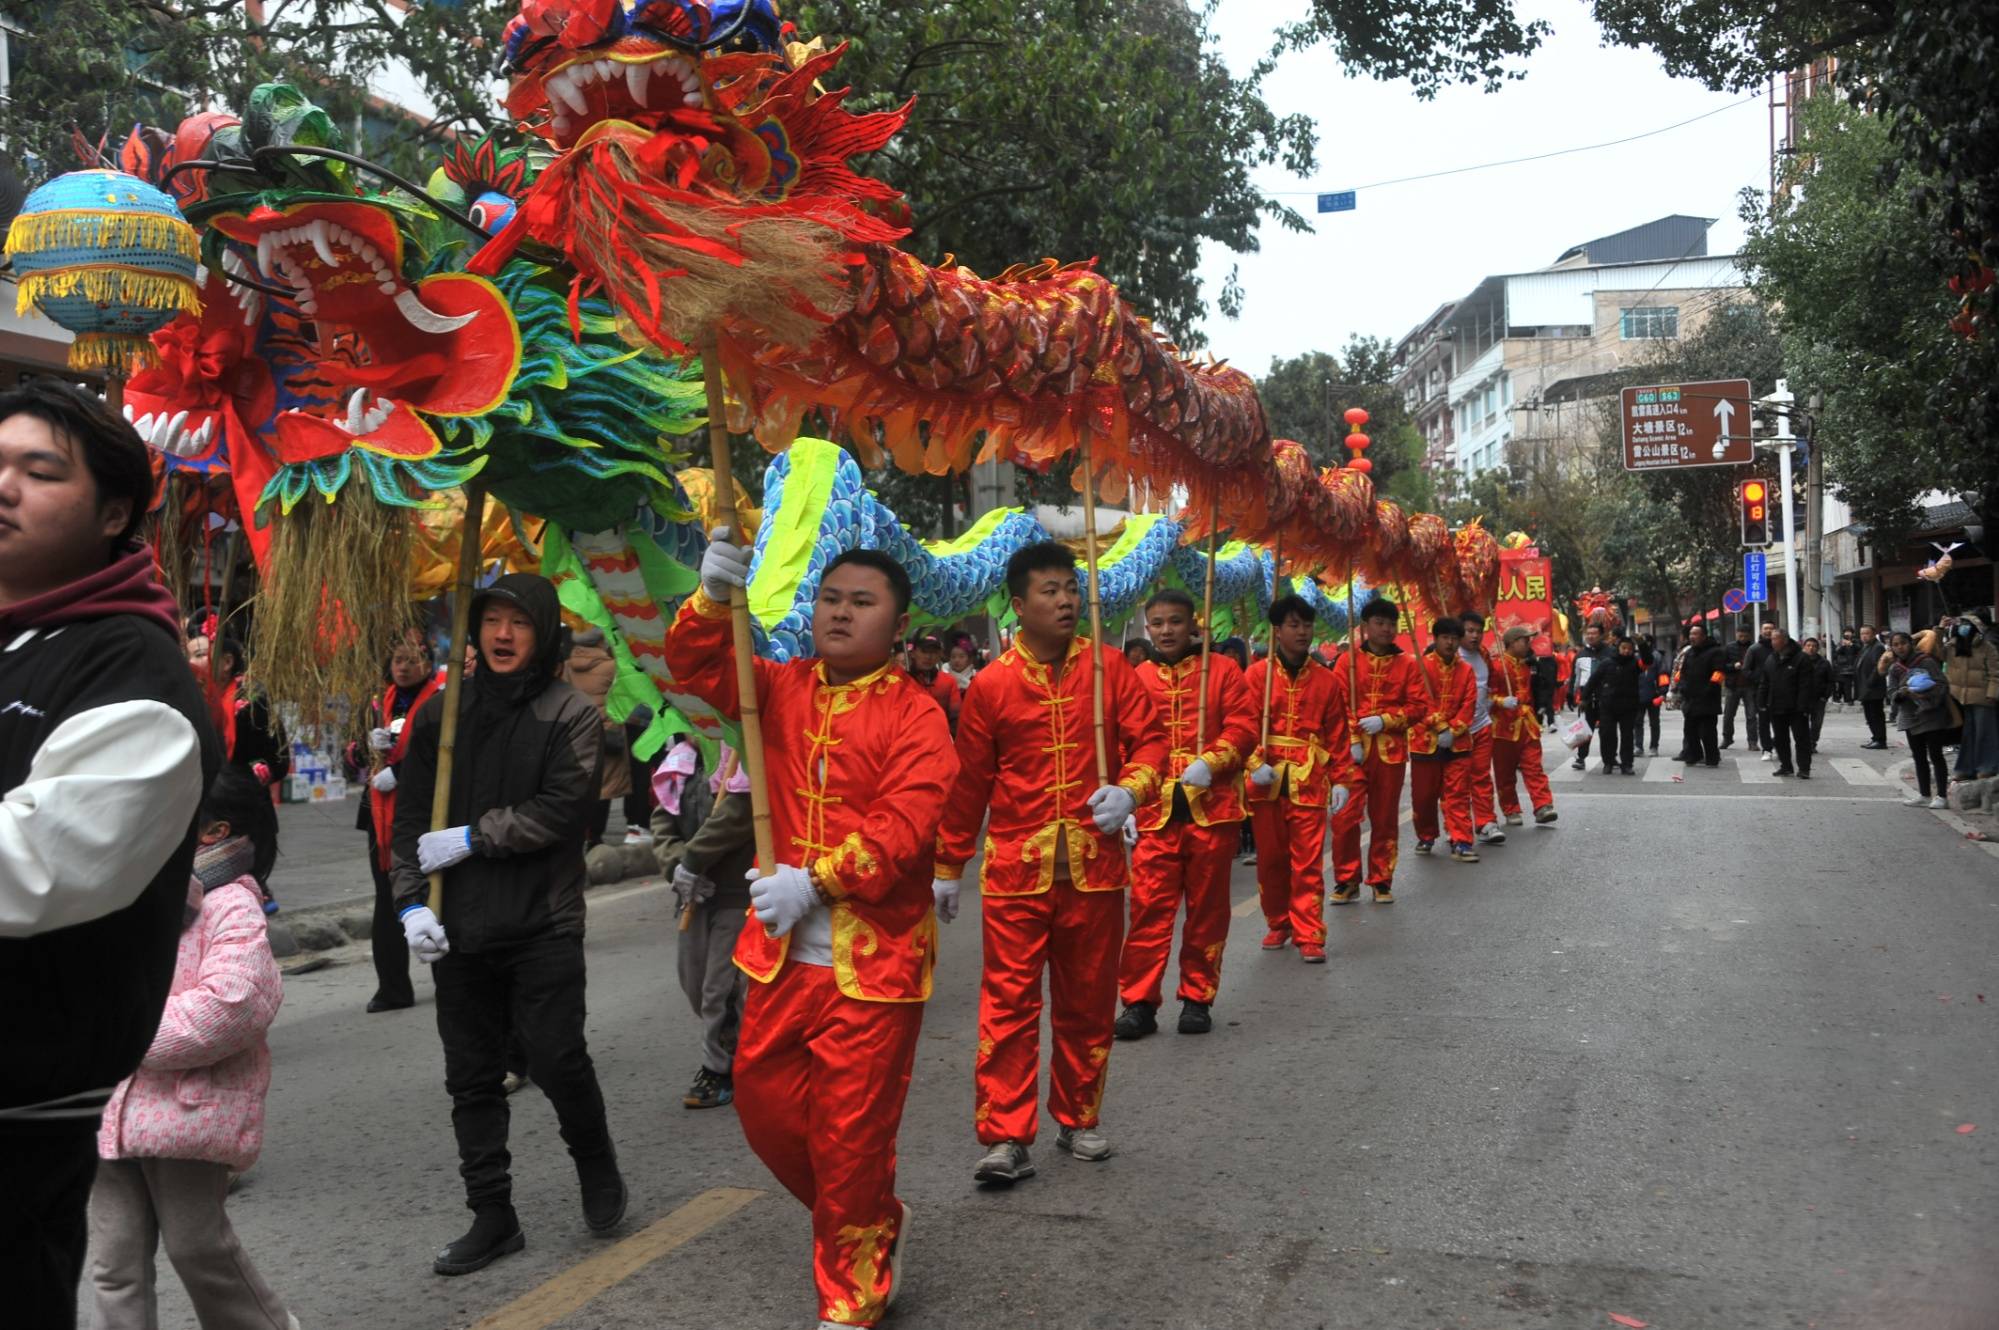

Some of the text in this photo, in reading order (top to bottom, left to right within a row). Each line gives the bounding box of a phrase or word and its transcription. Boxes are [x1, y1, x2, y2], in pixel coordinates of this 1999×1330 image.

[1750, 554, 1761, 600] 红灯可右转
